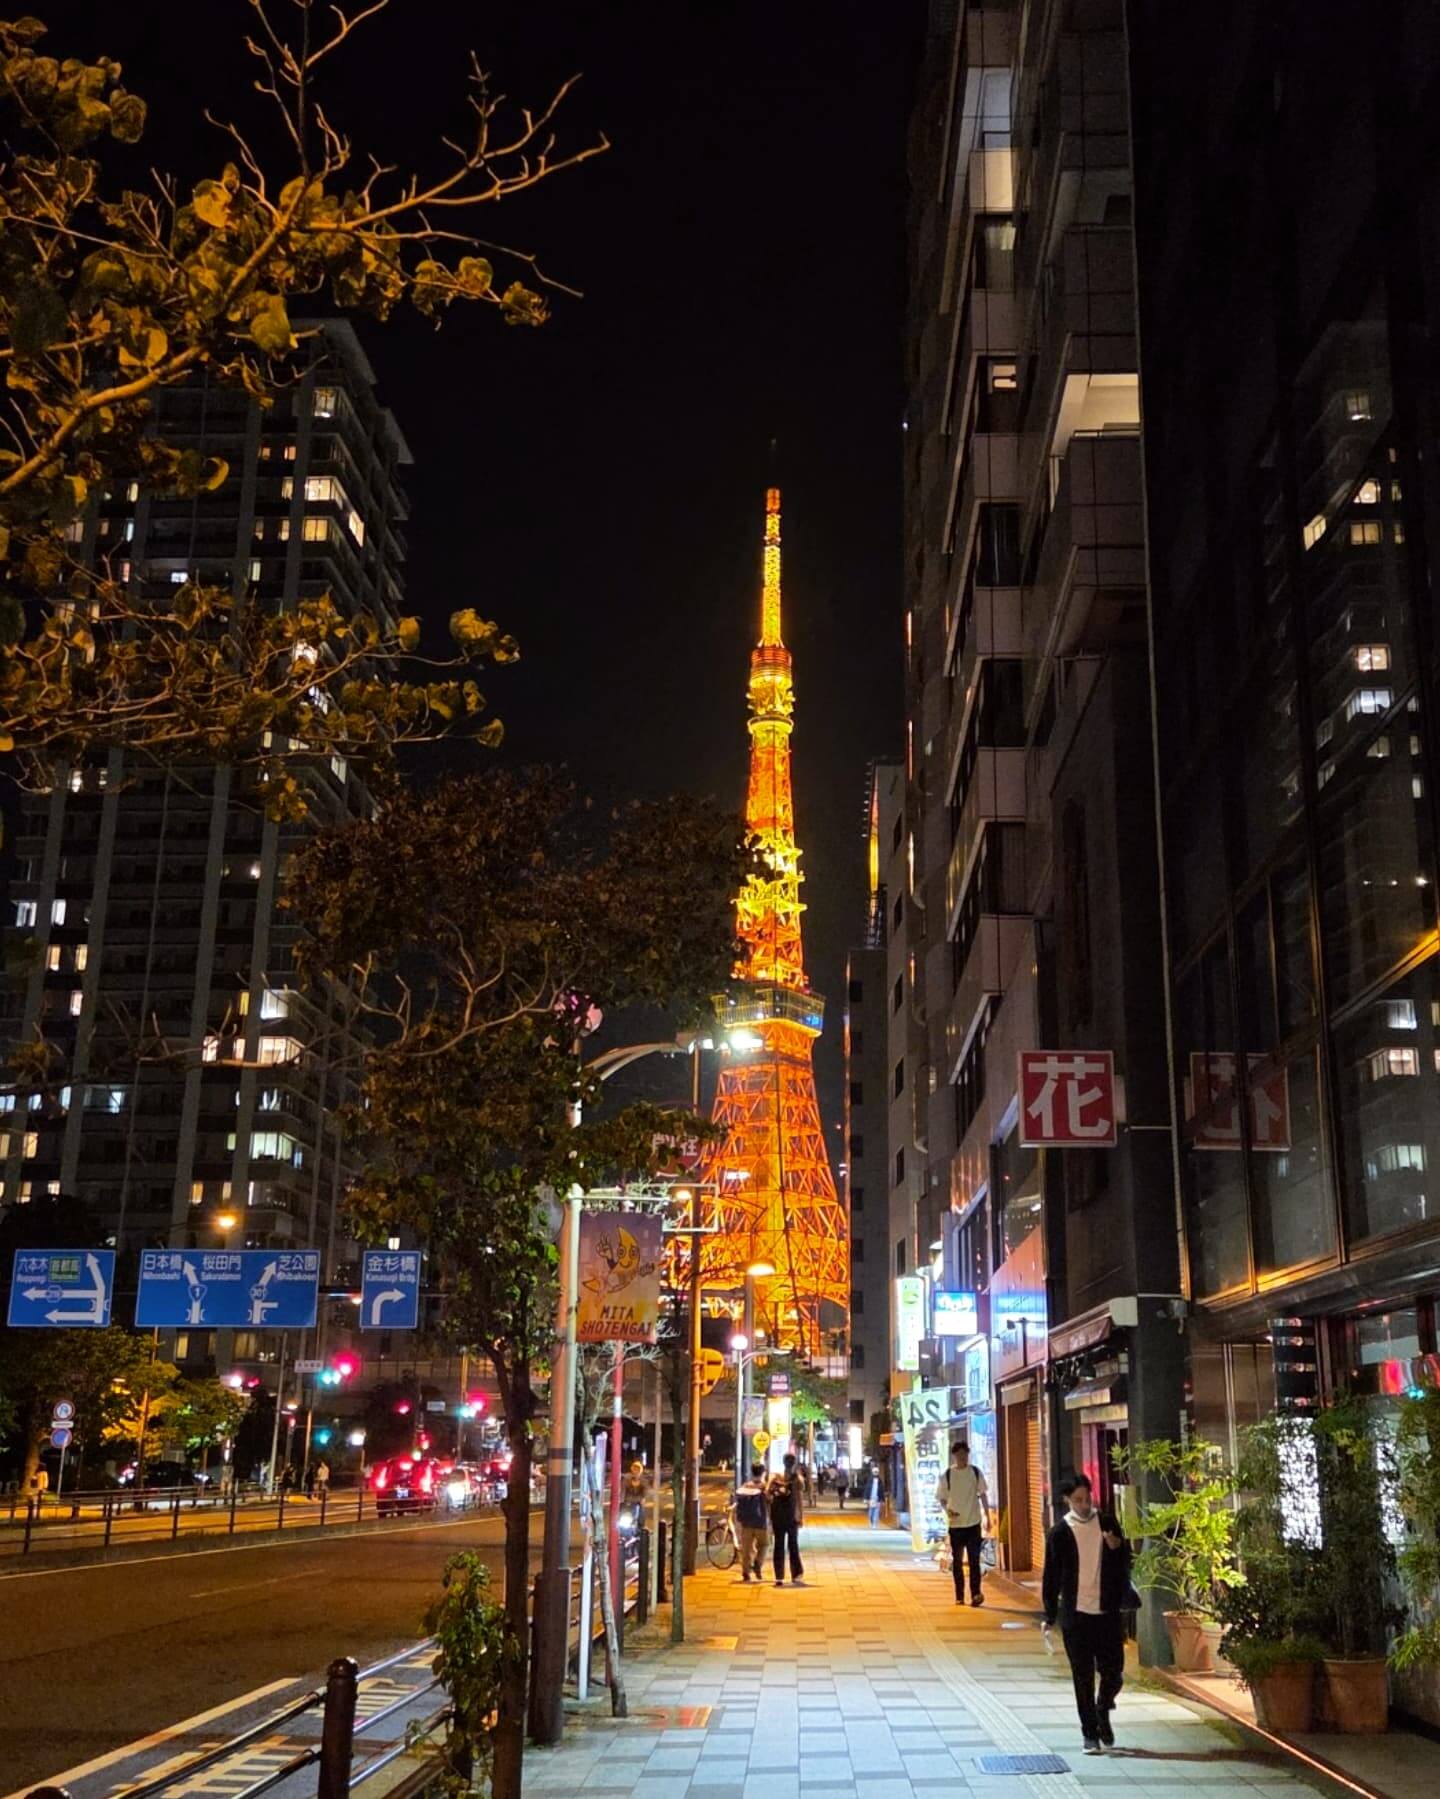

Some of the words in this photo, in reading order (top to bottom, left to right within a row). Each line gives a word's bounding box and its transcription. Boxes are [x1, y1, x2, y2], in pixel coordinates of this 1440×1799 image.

[1027, 1055, 1111, 1138] 花
[17, 1257, 48, 1272] 六本木
[143, 1254, 182, 1271] 日本橋
[202, 1255, 242, 1271] 桜田門
[277, 1255, 317, 1271] 芝公園
[367, 1255, 416, 1272] 金杉橋
[601, 1304, 634, 1320] MITA
[581, 1319, 652, 1336] SHOTENGAI
